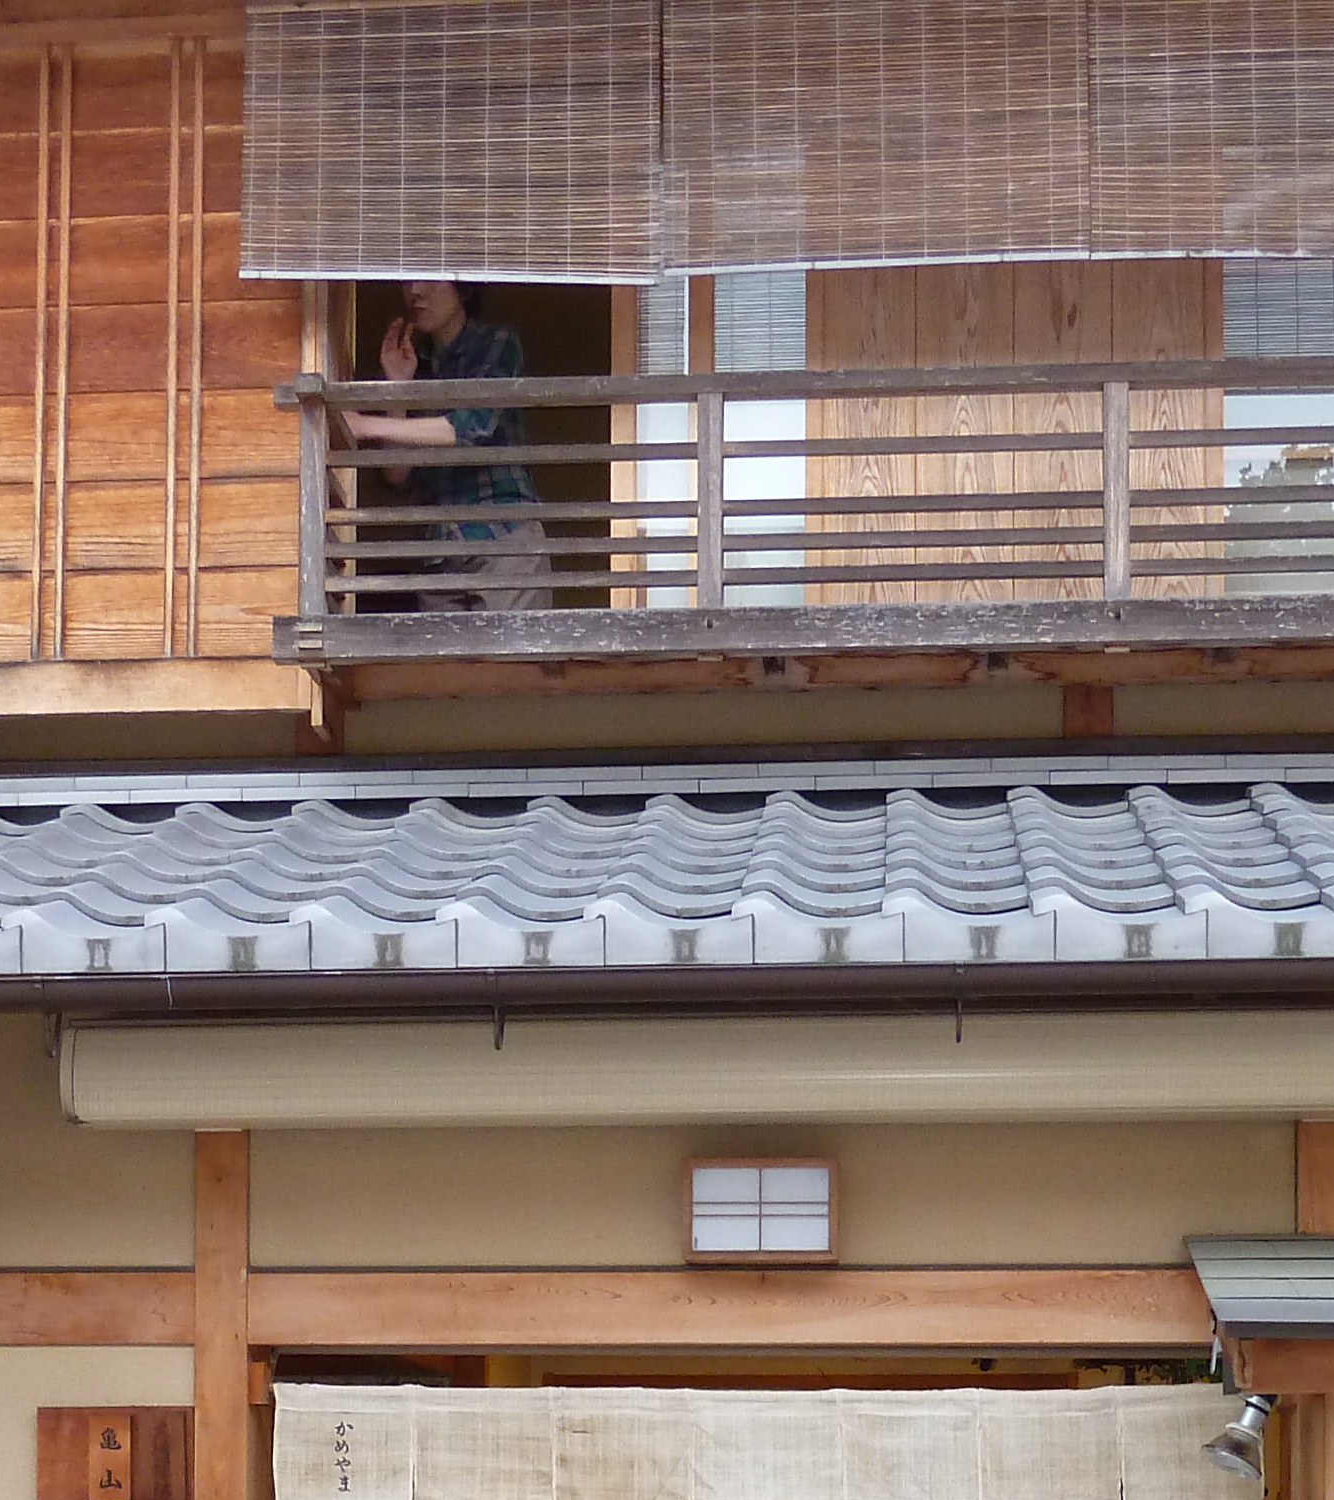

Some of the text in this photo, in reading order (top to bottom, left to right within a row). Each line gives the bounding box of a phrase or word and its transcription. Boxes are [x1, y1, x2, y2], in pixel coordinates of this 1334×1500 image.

[99, 1427, 123, 1490] 亀山
[333, 1420, 354, 1494] かめやま
